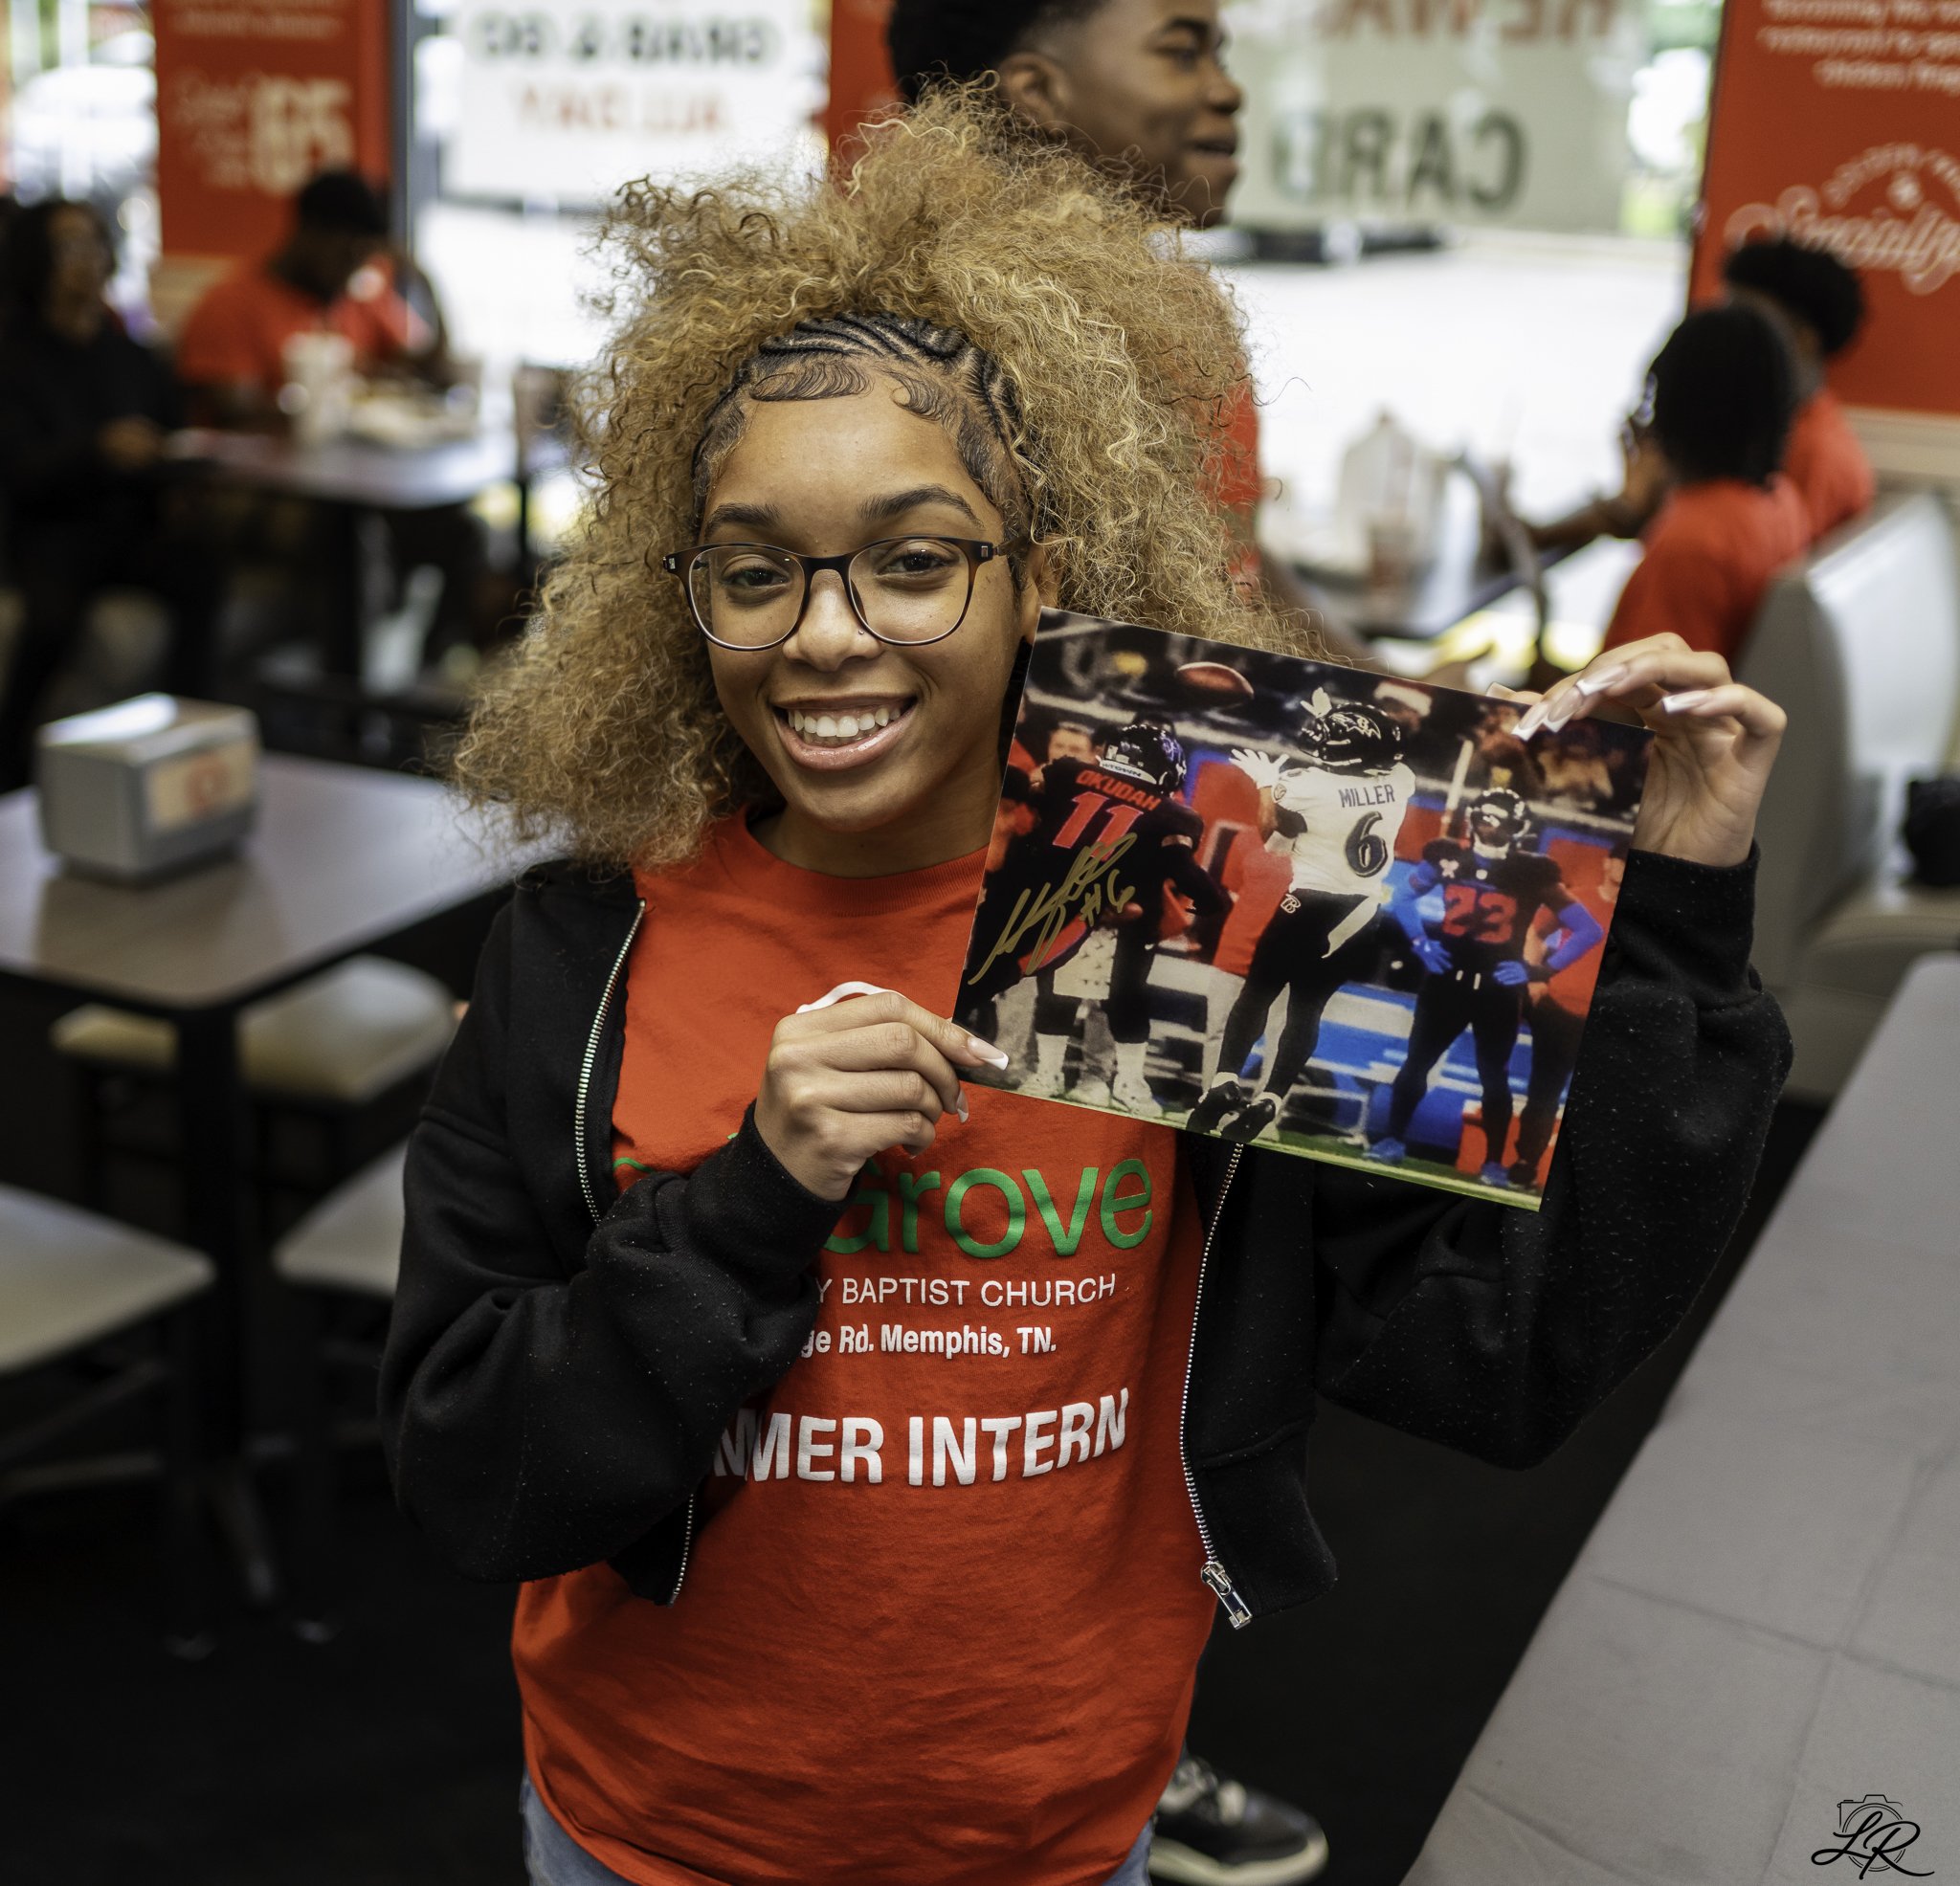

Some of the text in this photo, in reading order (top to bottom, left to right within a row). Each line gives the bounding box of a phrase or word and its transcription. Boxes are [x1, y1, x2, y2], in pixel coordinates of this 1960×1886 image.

[1076, 769, 1162, 811] OKUDAH
[1338, 784, 1395, 808] MILLER
[1052, 791, 1144, 861] 11
[1345, 810, 1389, 878] 6
[1442, 883, 1517, 944] 23
[842, 1276, 970, 1305] BAPTIST
[981, 1273, 1116, 1307] CHURCH
[838, 1323, 874, 1354] Rd.
[880, 1323, 1011, 1360] Memphis,
[1016, 1326, 1057, 1354] TN.
[714, 1387, 1128, 1487] MMER INTERN
